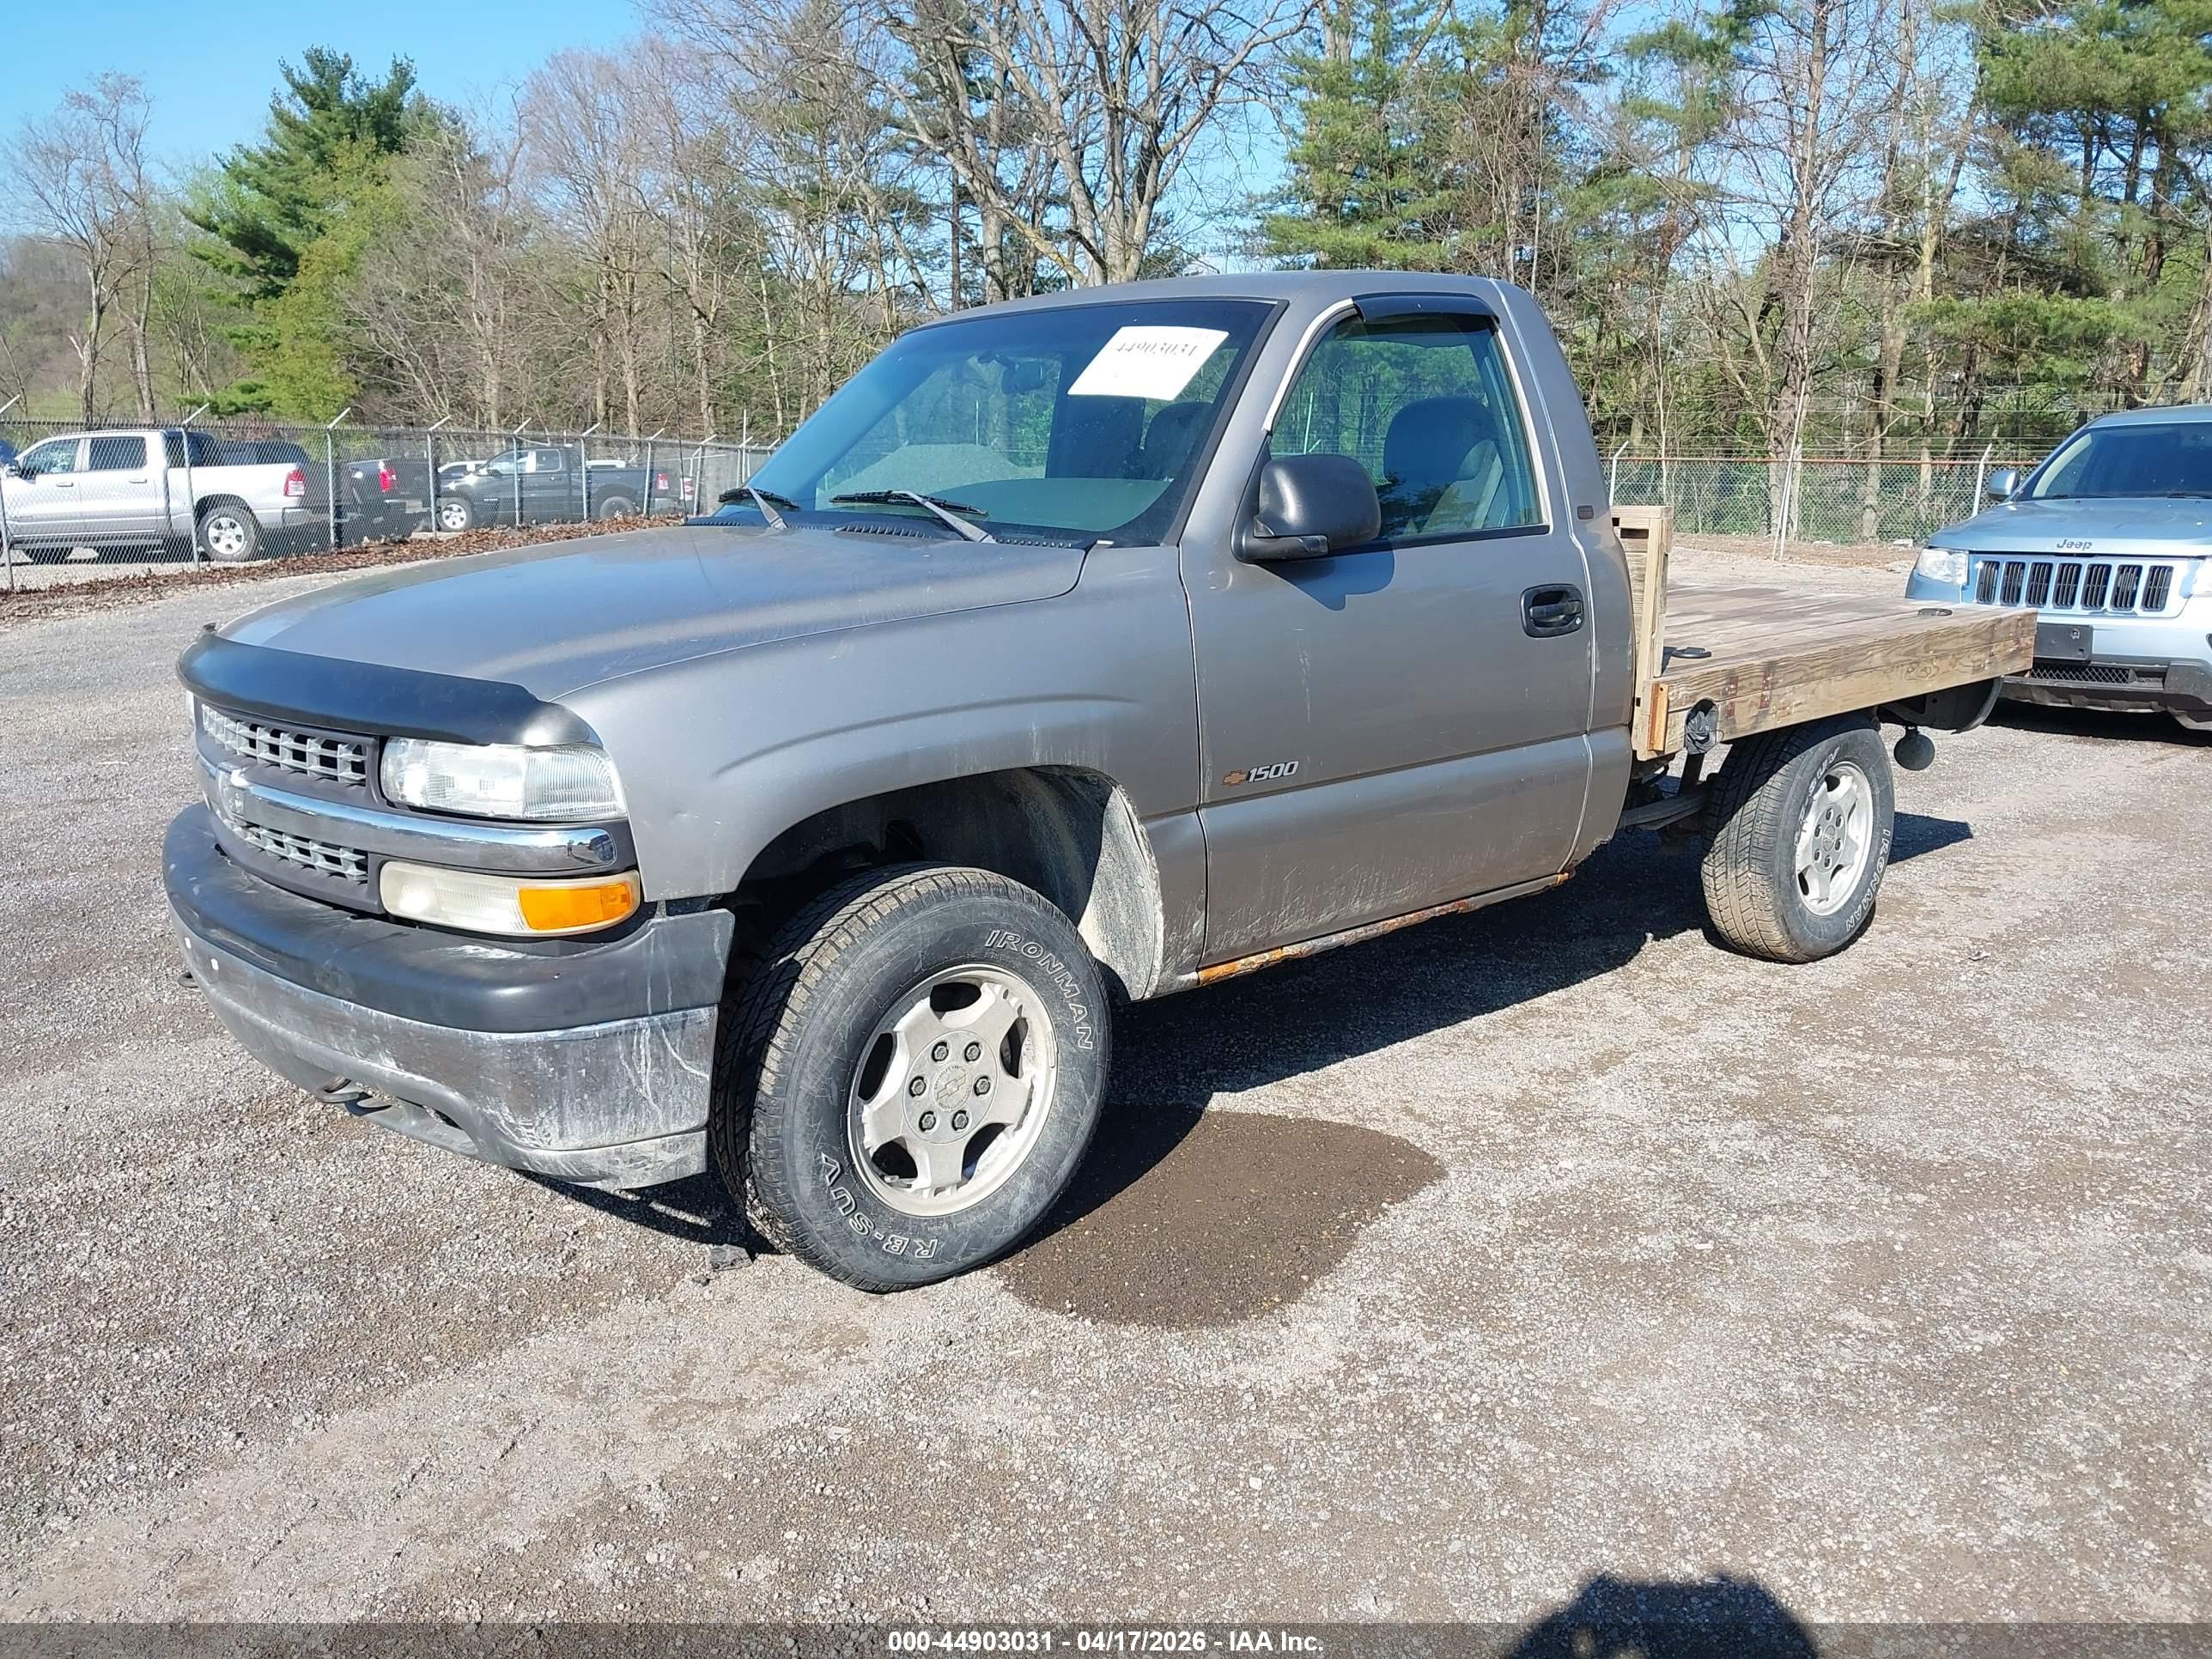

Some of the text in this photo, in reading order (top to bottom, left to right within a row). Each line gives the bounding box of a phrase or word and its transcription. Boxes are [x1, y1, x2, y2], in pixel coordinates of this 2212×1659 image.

[2056, 538, 2093, 550] Jeep
[1248, 760, 1299, 783] 1500
[1845, 828, 1891, 932] IRONMAN
[984, 930, 1093, 1049] IRONMAN
[821, 1152, 939, 1259] RB-SUV
